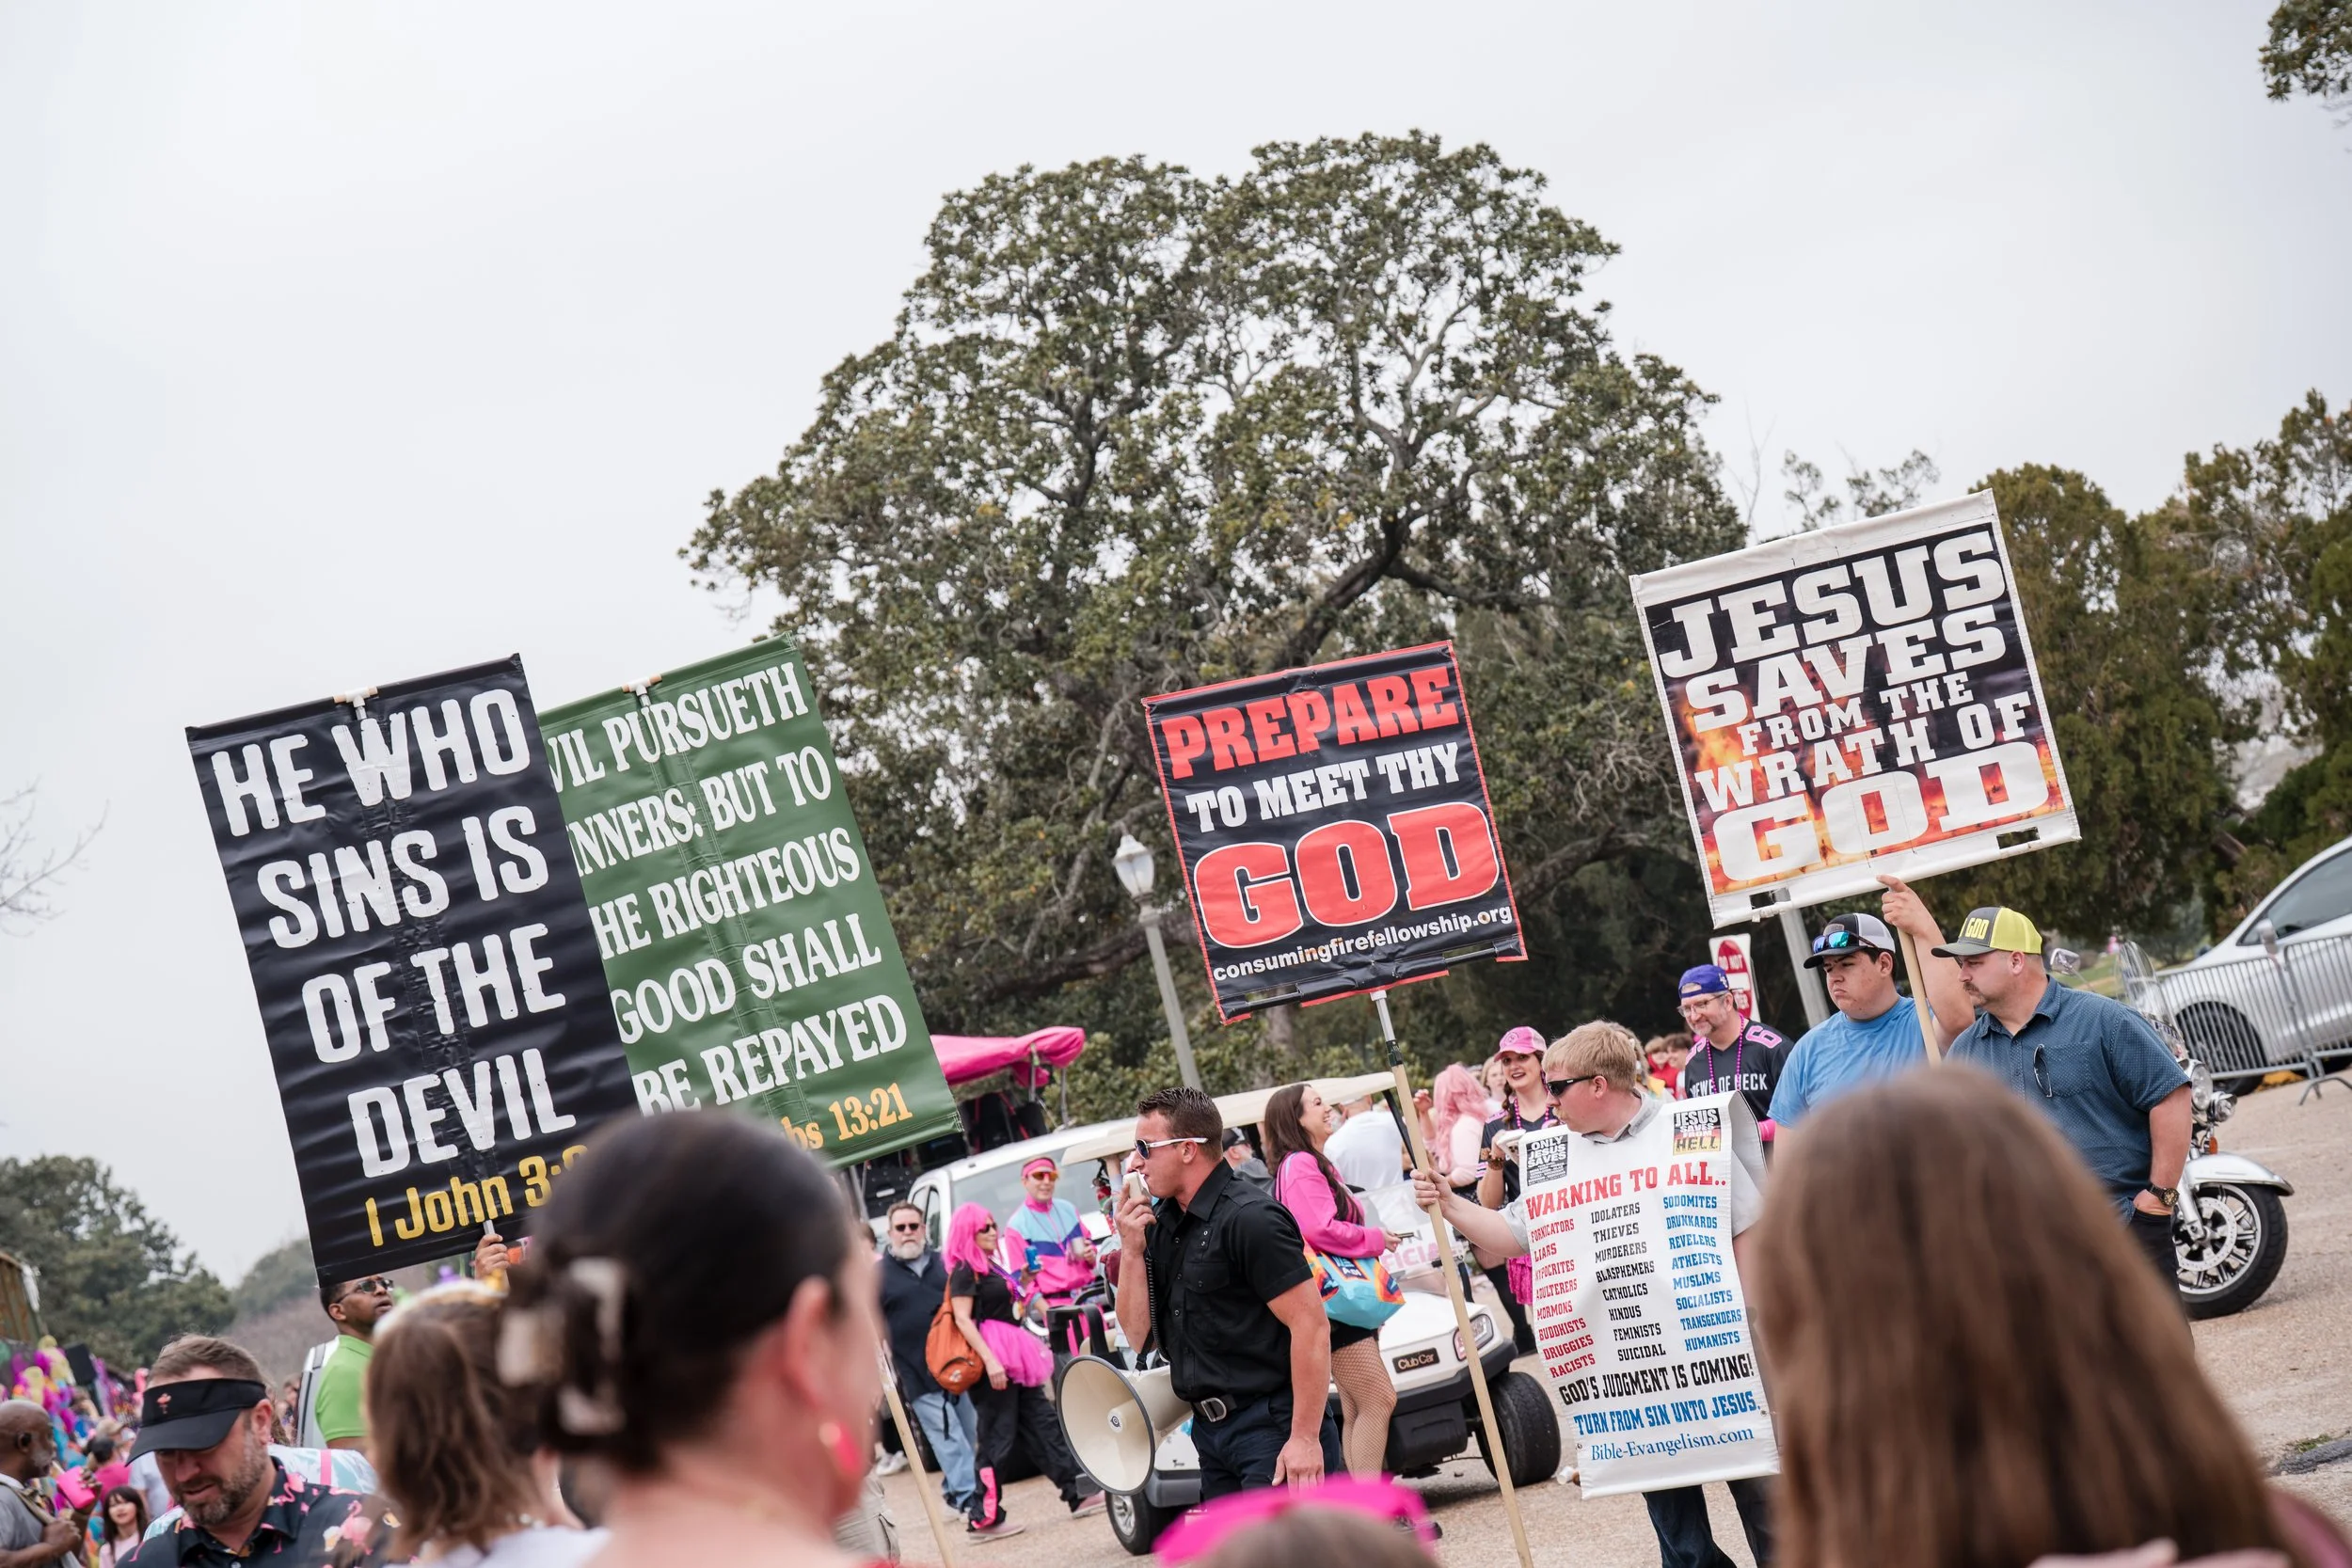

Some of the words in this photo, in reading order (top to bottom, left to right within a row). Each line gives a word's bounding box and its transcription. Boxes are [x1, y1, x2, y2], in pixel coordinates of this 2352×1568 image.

[1660, 531, 2006, 678] JESUS
[1685, 604, 2006, 734] SAVES
[1160, 666, 1459, 780] PREPARE
[1736, 696, 1867, 756] FROM
[1878, 671, 1974, 721] THE
[548, 729, 606, 793] VIL
[602, 662, 808, 772] PURSUETH
[211, 734, 326, 837] HE
[331, 689, 531, 807] WHO
[1693, 720, 1938, 813] WRATH
[1956, 690, 2032, 751] OF
[699, 761, 776, 831] BUT
[776, 746, 832, 806] TO
[1185, 785, 1248, 833] TO
[1252, 759, 1370, 821] MEET
[1378, 741, 1460, 794] THY
[1712, 741, 2049, 881] GOD
[257, 830, 450, 948] SINS
[462, 805, 548, 901] IS
[1193, 801, 1500, 949] GOD
[588, 893, 651, 959] HE
[647, 827, 860, 939] RIGHTEOUS
[1965, 917, 1989, 940] GOD
[1213, 906, 1513, 982] consumingfirefellowship.org
[610, 958, 736, 1044] GOOD
[742, 913, 882, 999] SHALL
[301, 961, 396, 1063] OF
[410, 923, 565, 1035] THE
[632, 1058, 702, 1117] BE
[700, 994, 908, 1105] REPAYED
[347, 1048, 576, 1178] DEVIL
[828, 1082, 913, 1141] 13:21
[1675, 1109, 1719, 1128] JESUS
[1528, 1143, 1566, 1160] JESUS
[1531, 1135, 1564, 1150] ONLY
[1676, 1136, 1718, 1151] HELL
[1527, 1151, 1567, 1168] SAVES
[1525, 1173, 1622, 1220] WARNING
[1629, 1166, 1658, 1193] TO
[1663, 1196, 1717, 1210] SODOMITES
[394, 1176, 514, 1240] John
[1591, 1202, 1641, 1225] IDOLATERS
[1593, 1223, 1640, 1243] THIEVES
[1666, 1215, 1718, 1230] DRUNKARDS
[1534, 1243, 1557, 1262] LIARS
[1595, 1242, 1647, 1264] MURDERERS
[1668, 1234, 1717, 1250] REVELERS
[1596, 1260, 1655, 1283] BLASPHEMERS
[1671, 1253, 1723, 1270] ATHEISTS
[1602, 1283, 1648, 1302] CATHOLICS
[1673, 1272, 1722, 1290] MUSLIMS
[1536, 1300, 1573, 1321] MORMONS
[1608, 1305, 1642, 1321] HINDUS
[1676, 1290, 1733, 1310] SOCIALISTS
[1538, 1317, 1587, 1341] BUDDHISTS
[1613, 1323, 1661, 1341] FEMINISTS
[1680, 1308, 1742, 1331] TRANSGENDERS
[1543, 1334, 1594, 1360] DRUGGIES
[1617, 1343, 1666, 1362] SUICIDAL
[1684, 1331, 1740, 1352] HUMANISTS
[1549, 1353, 1596, 1379] RACISTS
[1558, 1376, 1600, 1405] GOD'S
[1602, 1367, 1670, 1399] JUDGMENT
[1672, 1365, 1689, 1389] IS
[1692, 1353, 1755, 1386] COMING!
[1573, 1411, 1609, 1435] TURN
[1610, 1408, 1645, 1432] FROM
[1645, 1403, 1671, 1427] SIN
[1670, 1399, 1708, 1423] UNTO
[1711, 1390, 1761, 1418] JESUS.
[1591, 1428, 1755, 1461] Bible-Evangelism.com
